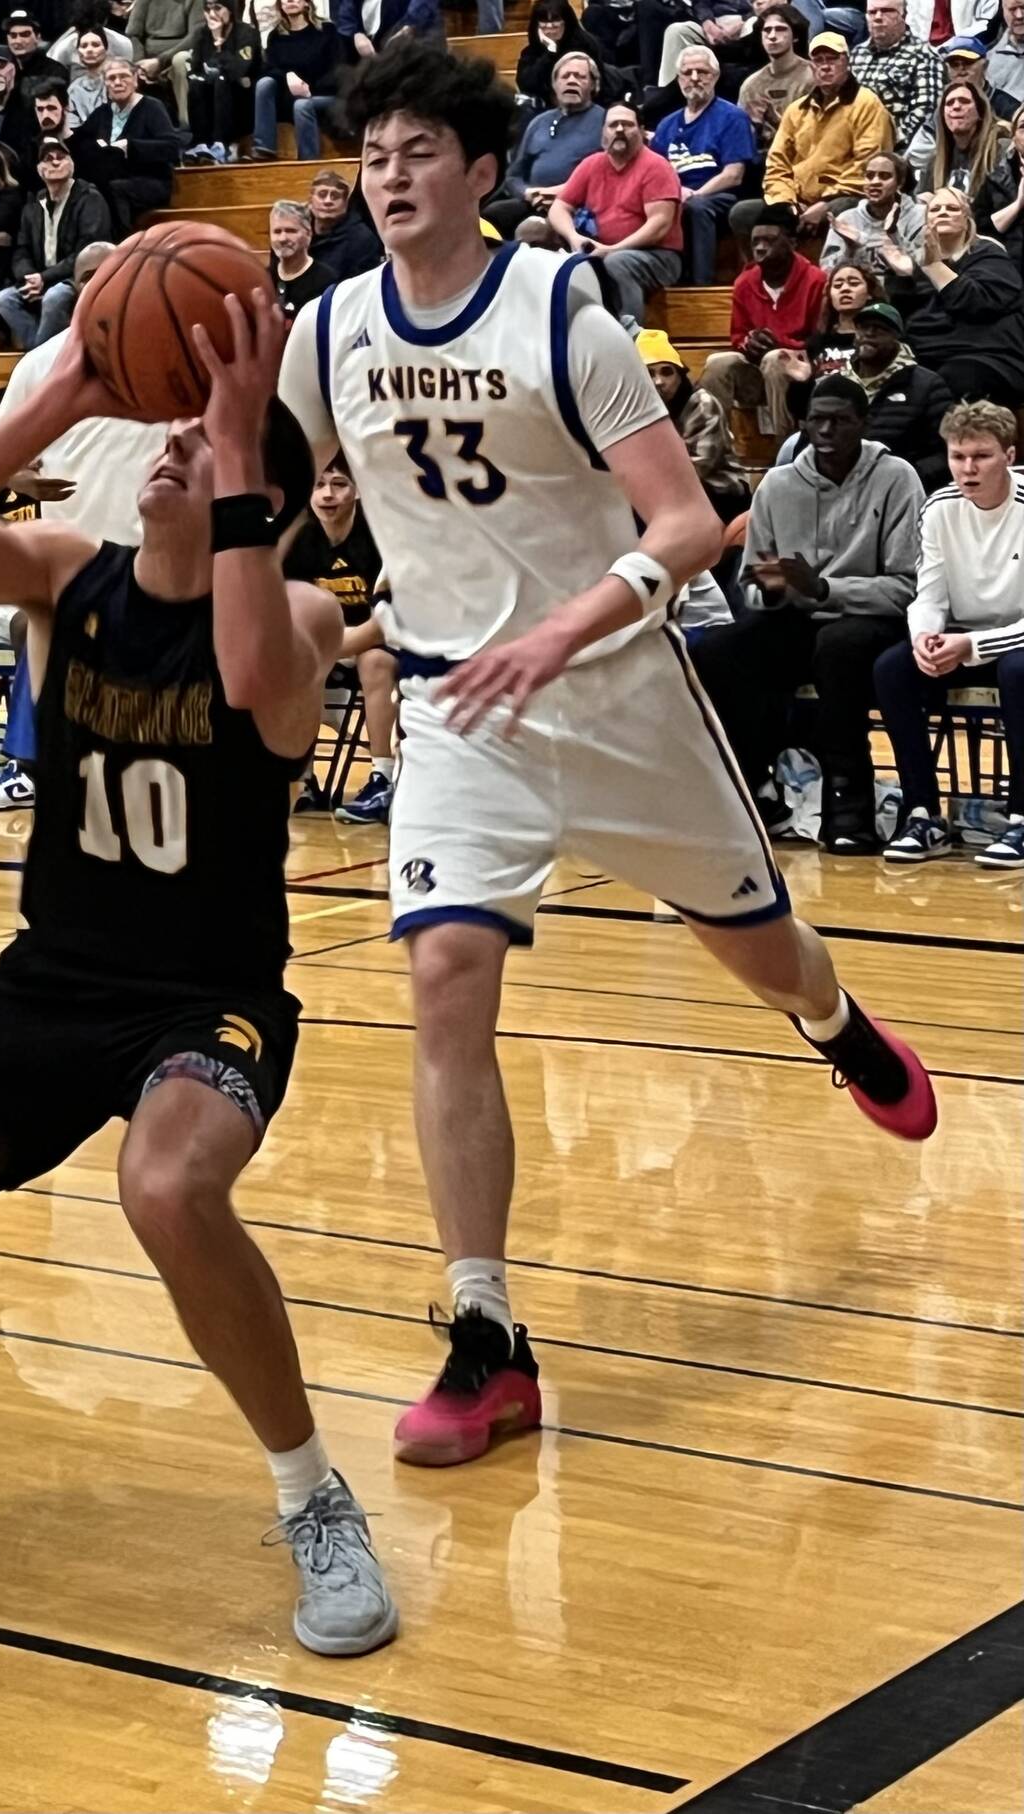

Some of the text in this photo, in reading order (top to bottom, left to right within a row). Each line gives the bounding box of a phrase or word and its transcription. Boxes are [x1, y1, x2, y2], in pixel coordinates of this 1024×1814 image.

[368, 366, 507, 402] KNIGHTS
[394, 419, 507, 505] 33
[78, 751, 187, 874] 10
